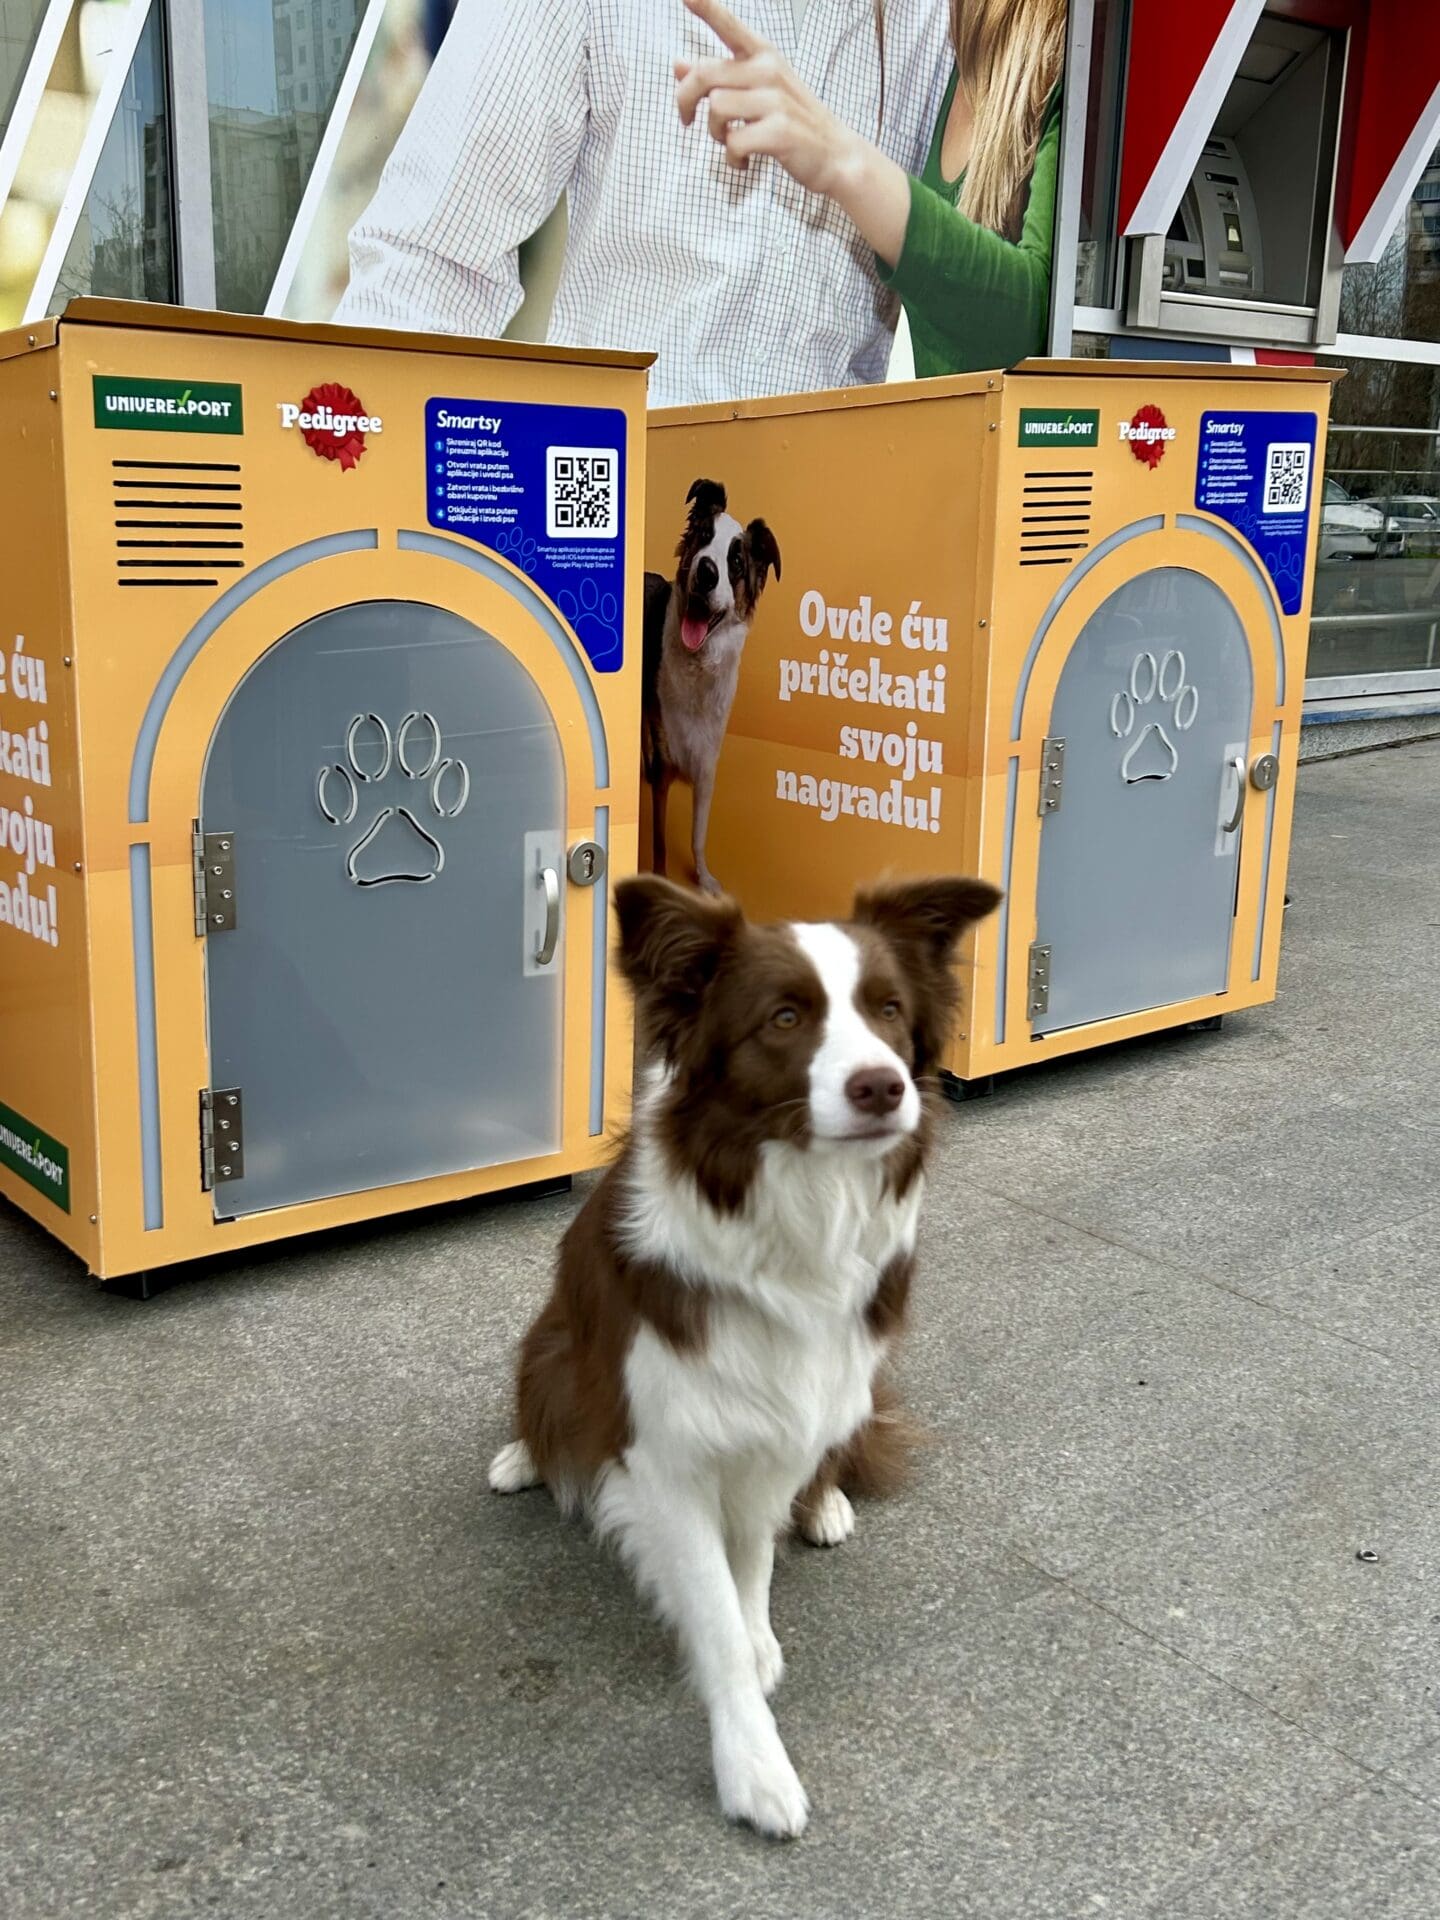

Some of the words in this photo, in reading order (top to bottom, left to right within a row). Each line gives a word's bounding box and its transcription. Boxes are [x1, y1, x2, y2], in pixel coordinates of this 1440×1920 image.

[105, 390, 232, 417] UNIVEREXPORT
[280, 403, 382, 437] Pedigree
[436, 409, 502, 434] Smartsy
[1025, 415, 1094, 434] UNIVEREXPORT
[1118, 421, 1176, 445] Pedigree
[1205, 419, 1245, 436] Smartsy
[476, 440, 488, 448] QR
[446, 460, 469, 469] Otvori
[470, 461, 487, 470] vrata
[446, 483, 471, 491] Zatvori
[472, 484, 489, 492] vrata
[799, 590, 892, 646] Ovde
[900, 600, 948, 652] ću
[12, 634, 48, 704] ću
[779, 649, 946, 714] pričekati
[839, 721, 943, 781] svoju
[776, 769, 942, 834] nagradu!
